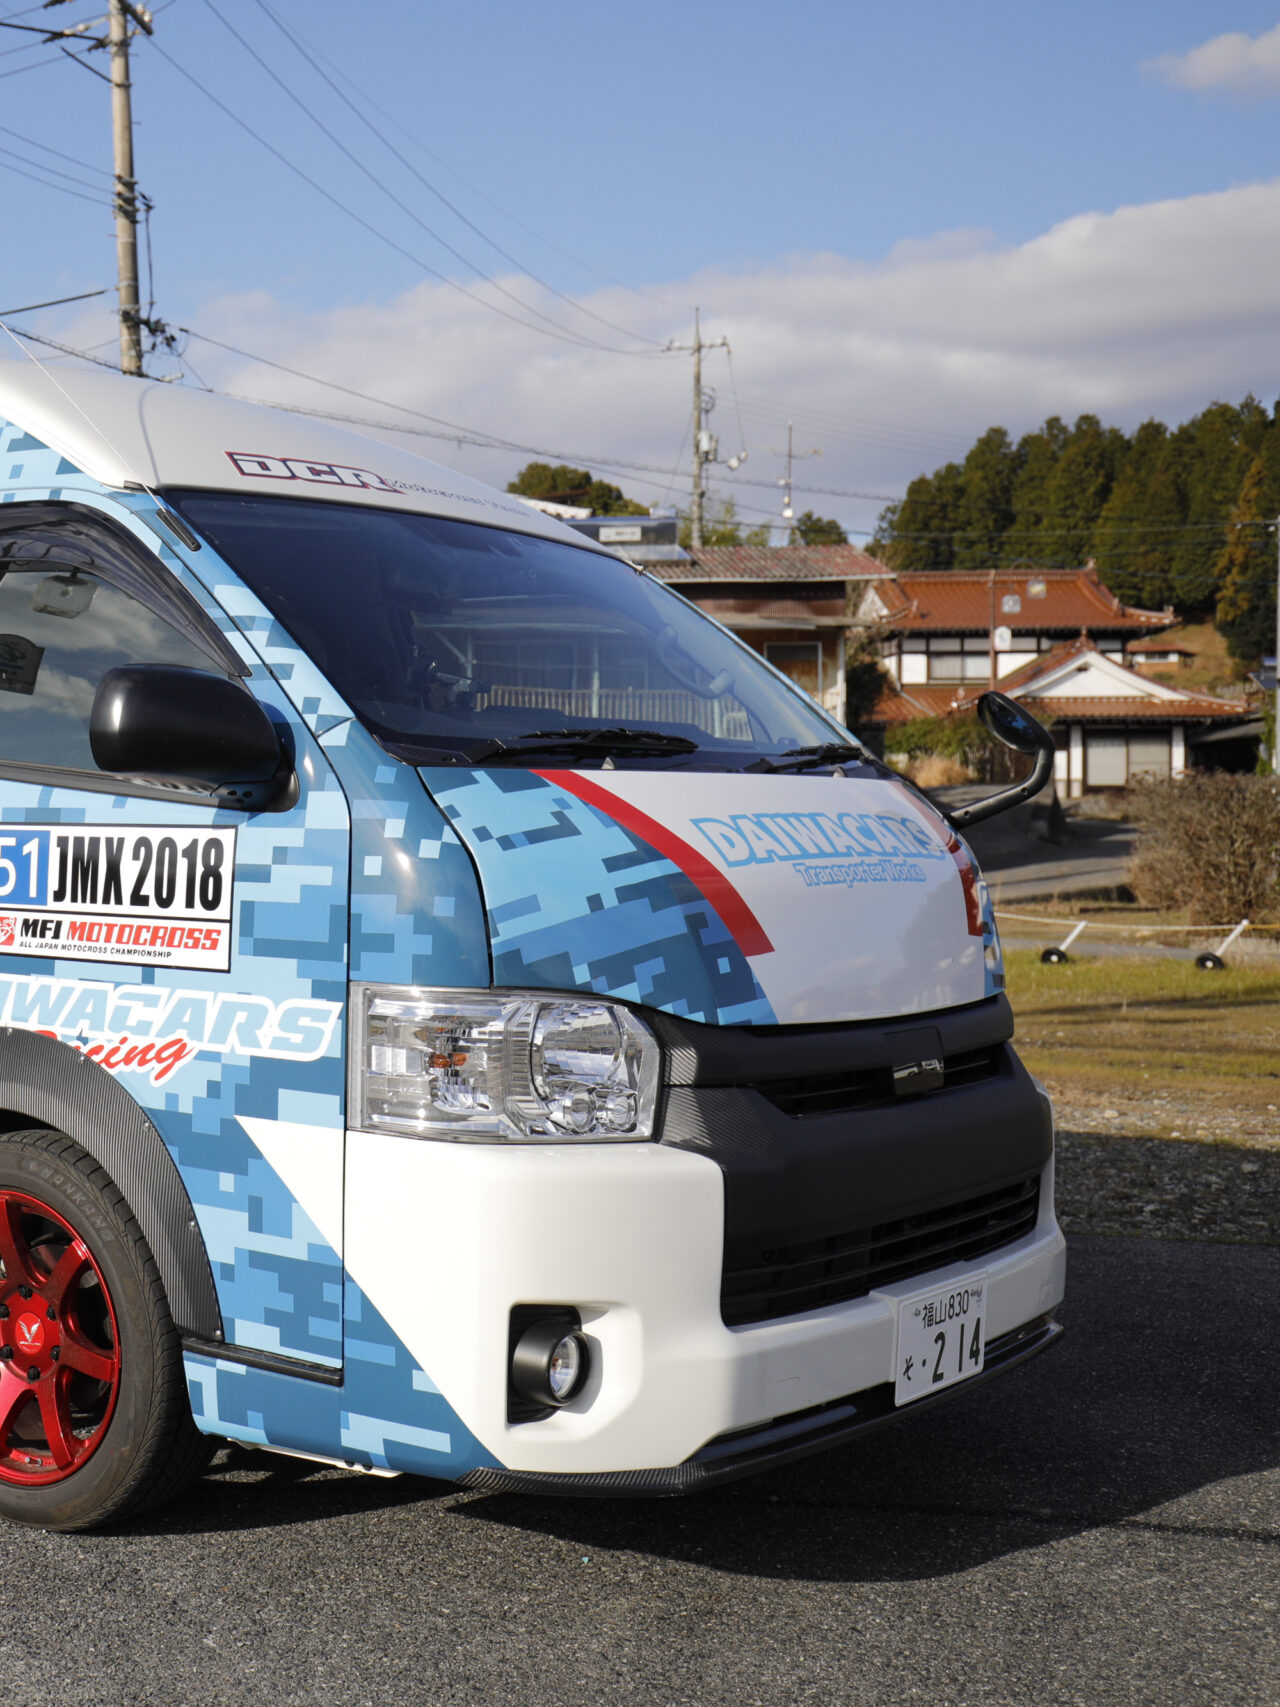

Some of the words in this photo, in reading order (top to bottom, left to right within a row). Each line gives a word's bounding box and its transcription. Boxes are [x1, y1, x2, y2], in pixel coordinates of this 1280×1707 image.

[226, 451, 406, 494] DCR
[689, 812, 946, 867] DAIWACARS
[793, 862, 882, 888] Transporter
[880, 860, 926, 882] Works
[20, 918, 62, 940] MFJ
[67, 921, 221, 950] MOTOCROSS
[61, 944, 108, 954] MOTOCROSS
[110, 947, 172, 958] CHAMPIONSHIP
